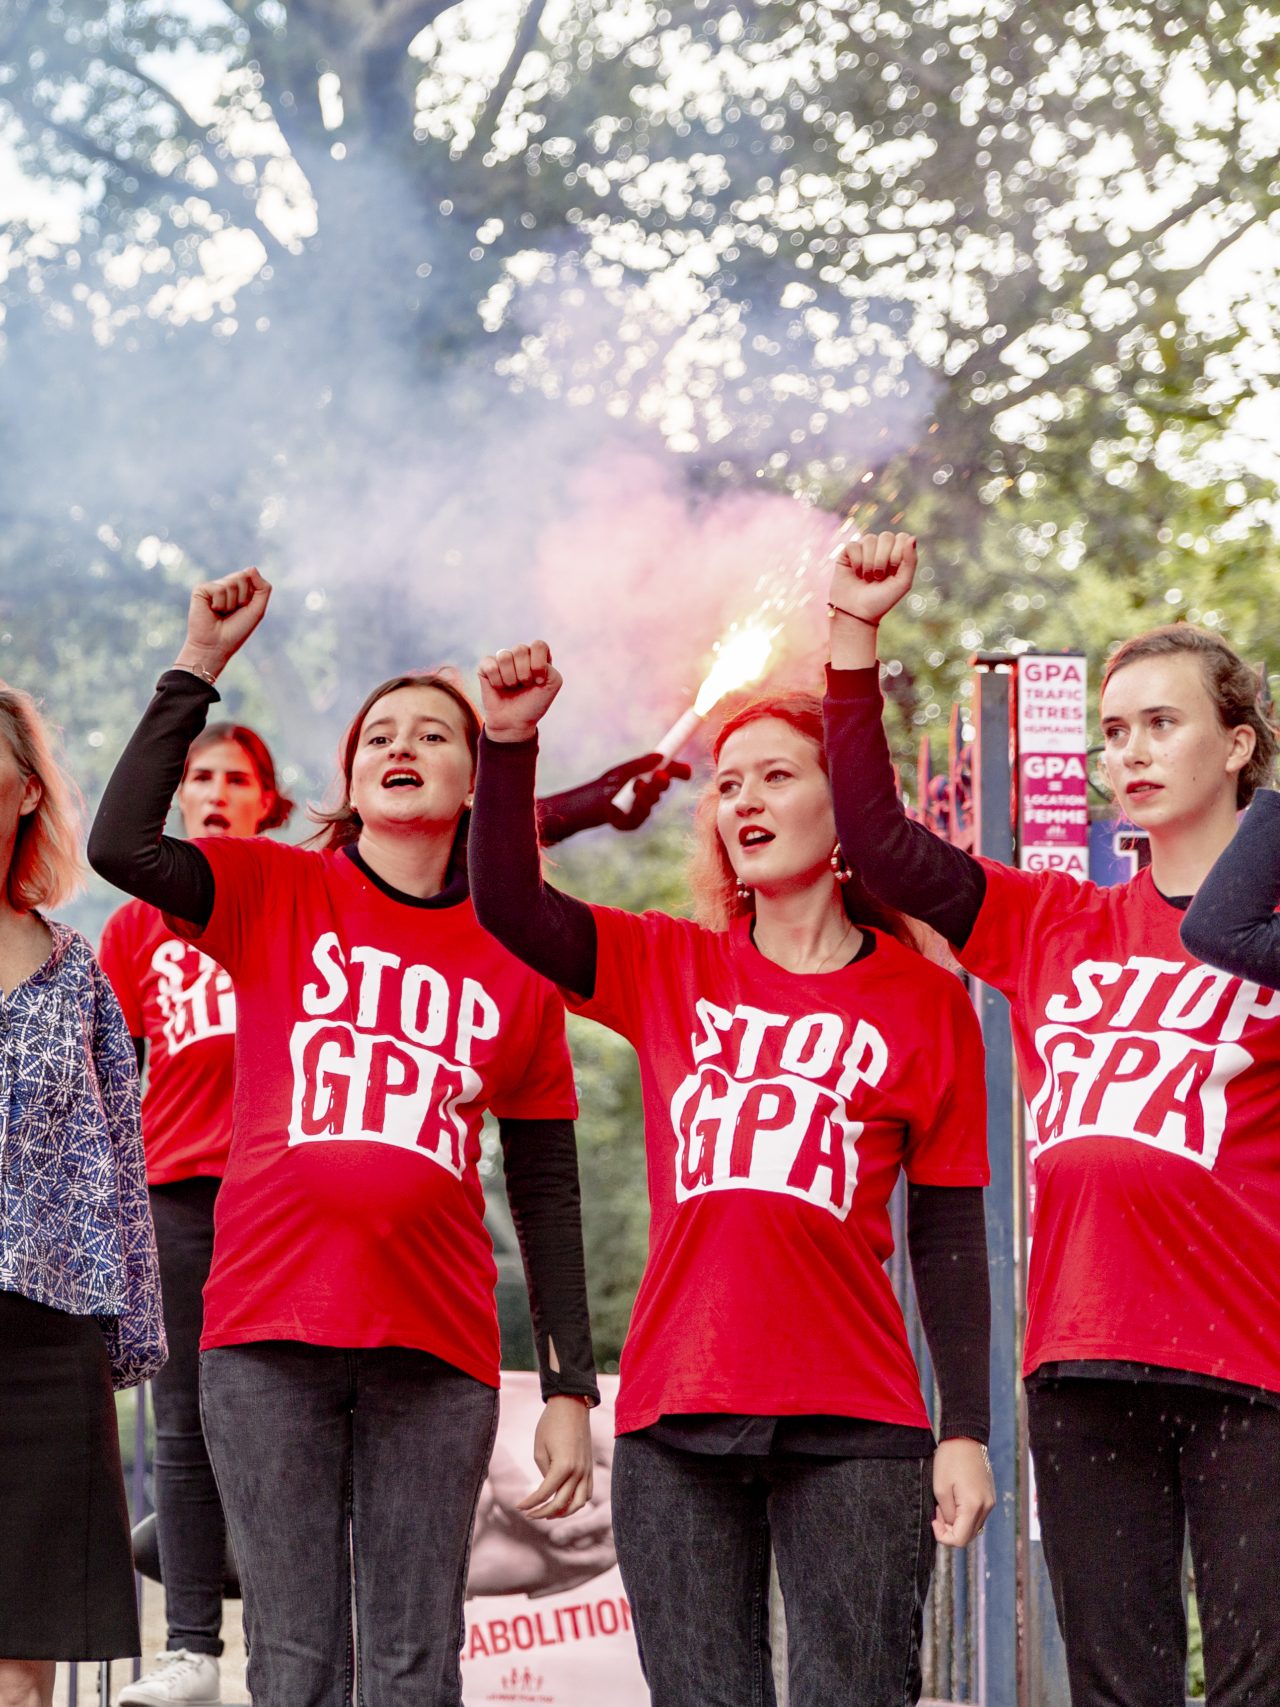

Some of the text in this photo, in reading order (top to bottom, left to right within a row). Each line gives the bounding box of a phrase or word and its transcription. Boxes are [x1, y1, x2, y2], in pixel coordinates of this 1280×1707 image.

[1025, 664, 1081, 682] GPA
[1024, 756, 1085, 779] GPA
[1024, 794, 1086, 806] LOCATION
[1024, 810, 1086, 824] FEMME
[1028, 854, 1083, 872] GPA
[302, 931, 500, 1066] STOP
[1045, 956, 1280, 1042] STOP
[691, 997, 888, 1100] STOP
[301, 1026, 463, 1170] GPA
[1036, 1032, 1217, 1155] GPA
[680, 1068, 847, 1209] GPA
